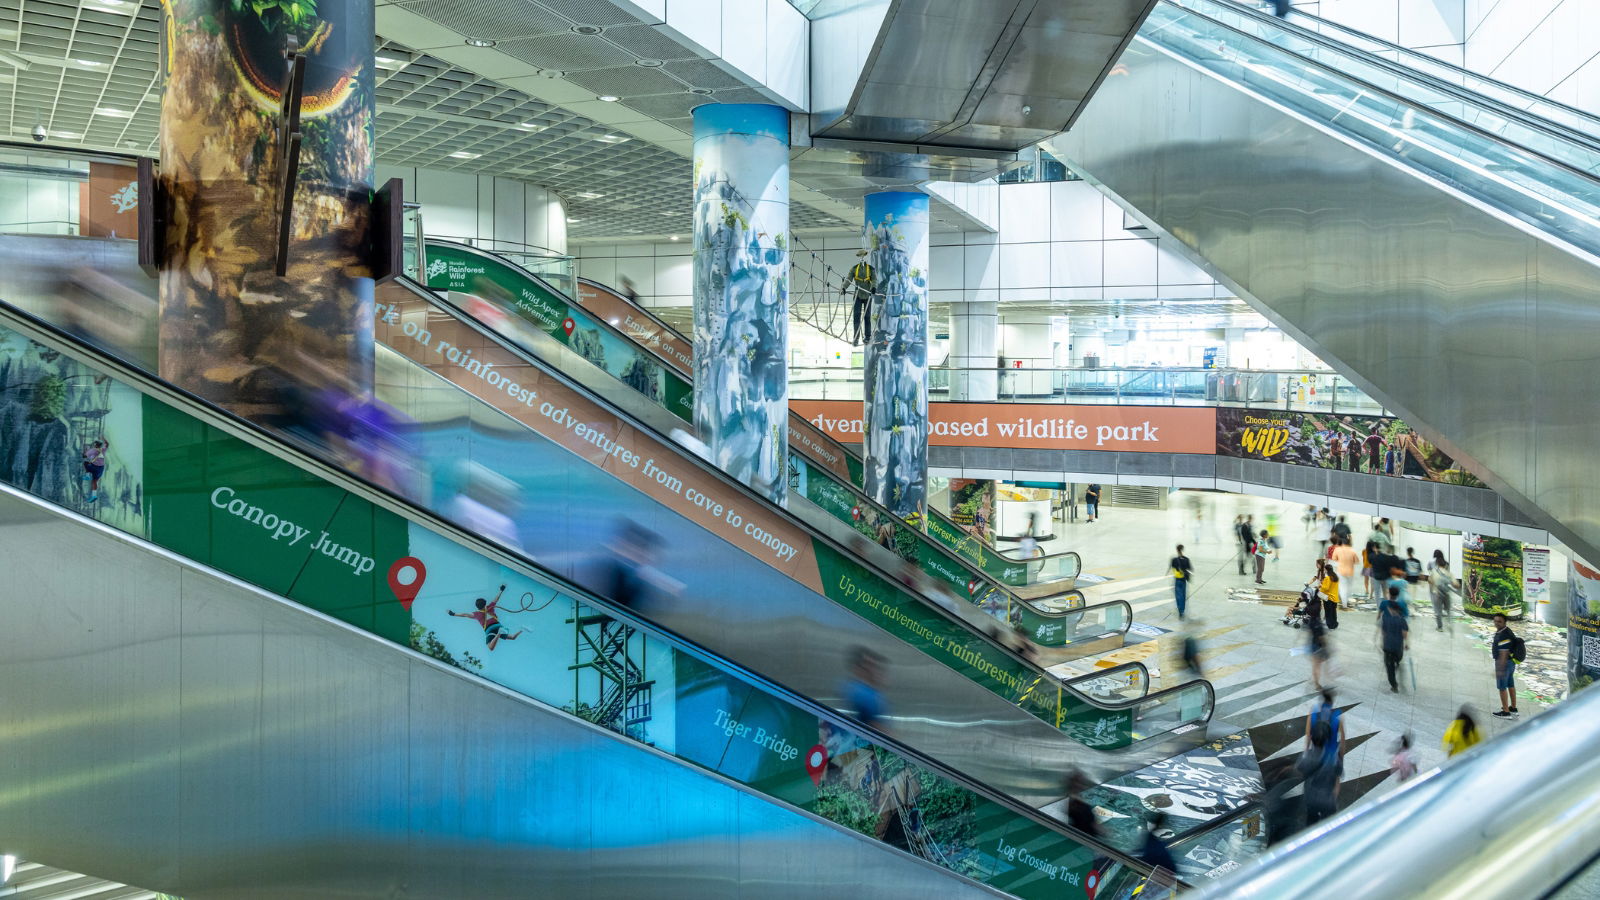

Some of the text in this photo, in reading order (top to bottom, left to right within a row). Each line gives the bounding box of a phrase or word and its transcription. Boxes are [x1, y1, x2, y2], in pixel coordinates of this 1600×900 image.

[449, 266, 485, 274] Rainforest
[515, 299, 558, 329] Adventure
[521, 289, 561, 318] Wild Apex
[662, 343, 675, 354] on
[807, 413, 864, 433] dven
[996, 417, 1089, 440] wildlife
[1096, 421, 1160, 446] park
[1244, 415, 1286, 427] Choose your
[403, 321, 432, 346] on
[435, 339, 537, 407] rainforest
[540, 402, 641, 468] adventures
[641, 459, 683, 495] from
[685, 488, 724, 517] cave
[726, 509, 743, 528] to
[744, 523, 798, 562] canopy
[802, 435, 811, 446] to
[811, 442, 838, 465] canopy
[210, 486, 376, 577] Canopy Jump
[927, 557, 938, 570] Log
[936, 564, 956, 583] Crossing
[839, 574, 856, 596] Up
[855, 588, 882, 610] your
[881, 604, 933, 641] adventure
[933, 635, 945, 648] at
[713, 708, 798, 761] Tiger Bridge
[996, 838, 1081, 887] Log Crossing Trek
